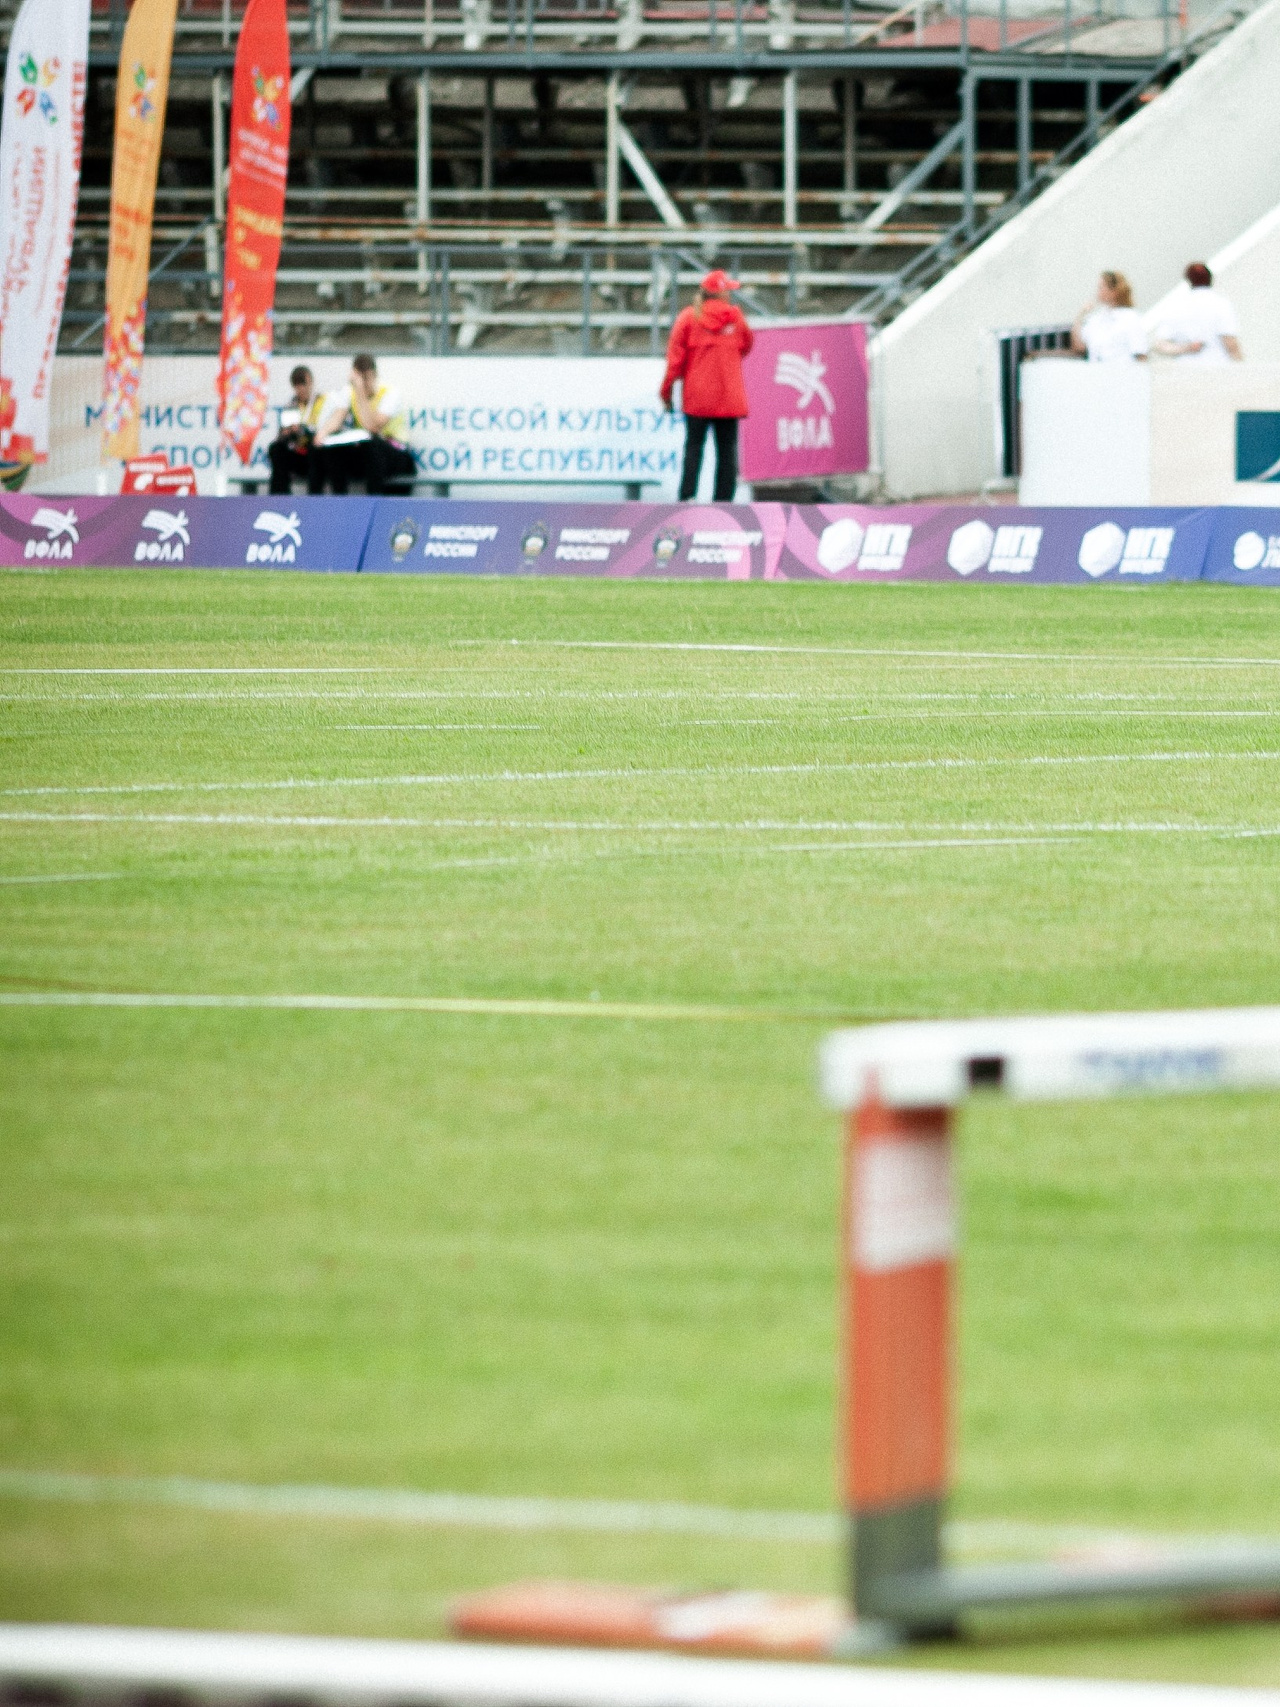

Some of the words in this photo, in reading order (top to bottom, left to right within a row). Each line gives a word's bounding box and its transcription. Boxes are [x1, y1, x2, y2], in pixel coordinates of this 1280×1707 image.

[409, 402, 548, 430] ИЧЕСКОЙ
[557, 407, 687, 432] КУЛЬТУР
[483, 448, 677, 471] РЕСПУБЛИКИ
[24, 538, 74, 560] ВФЛА
[134, 540, 185, 562] ВФЛА
[246, 542, 296, 563] ВФЛА
